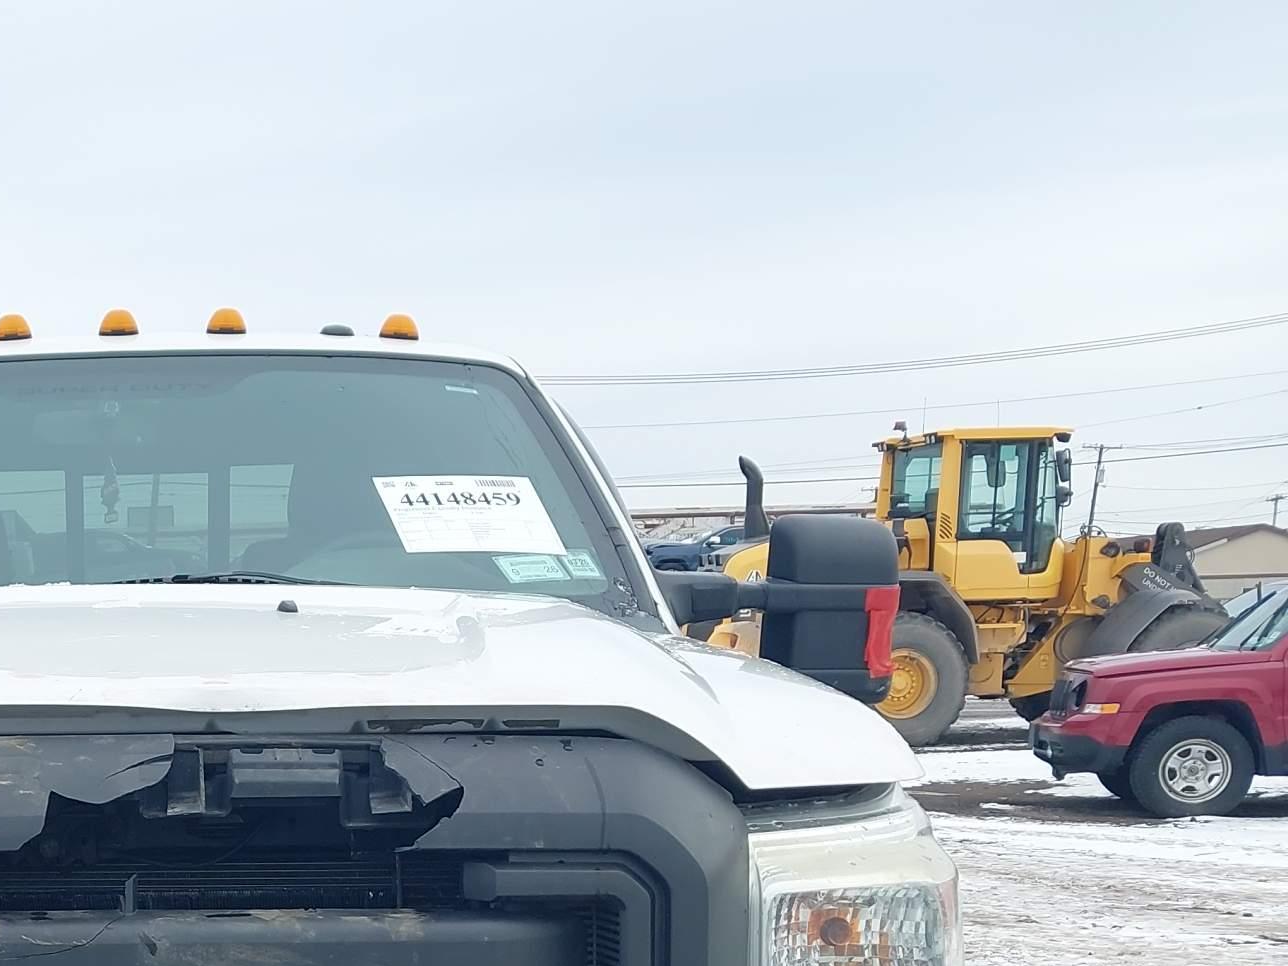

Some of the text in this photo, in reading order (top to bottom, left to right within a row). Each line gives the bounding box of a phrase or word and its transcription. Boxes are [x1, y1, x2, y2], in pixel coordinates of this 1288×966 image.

[400, 491, 521, 507] 44148459
[1143, 567, 1155, 578] DO
[1154, 575, 1171, 589] NOT
